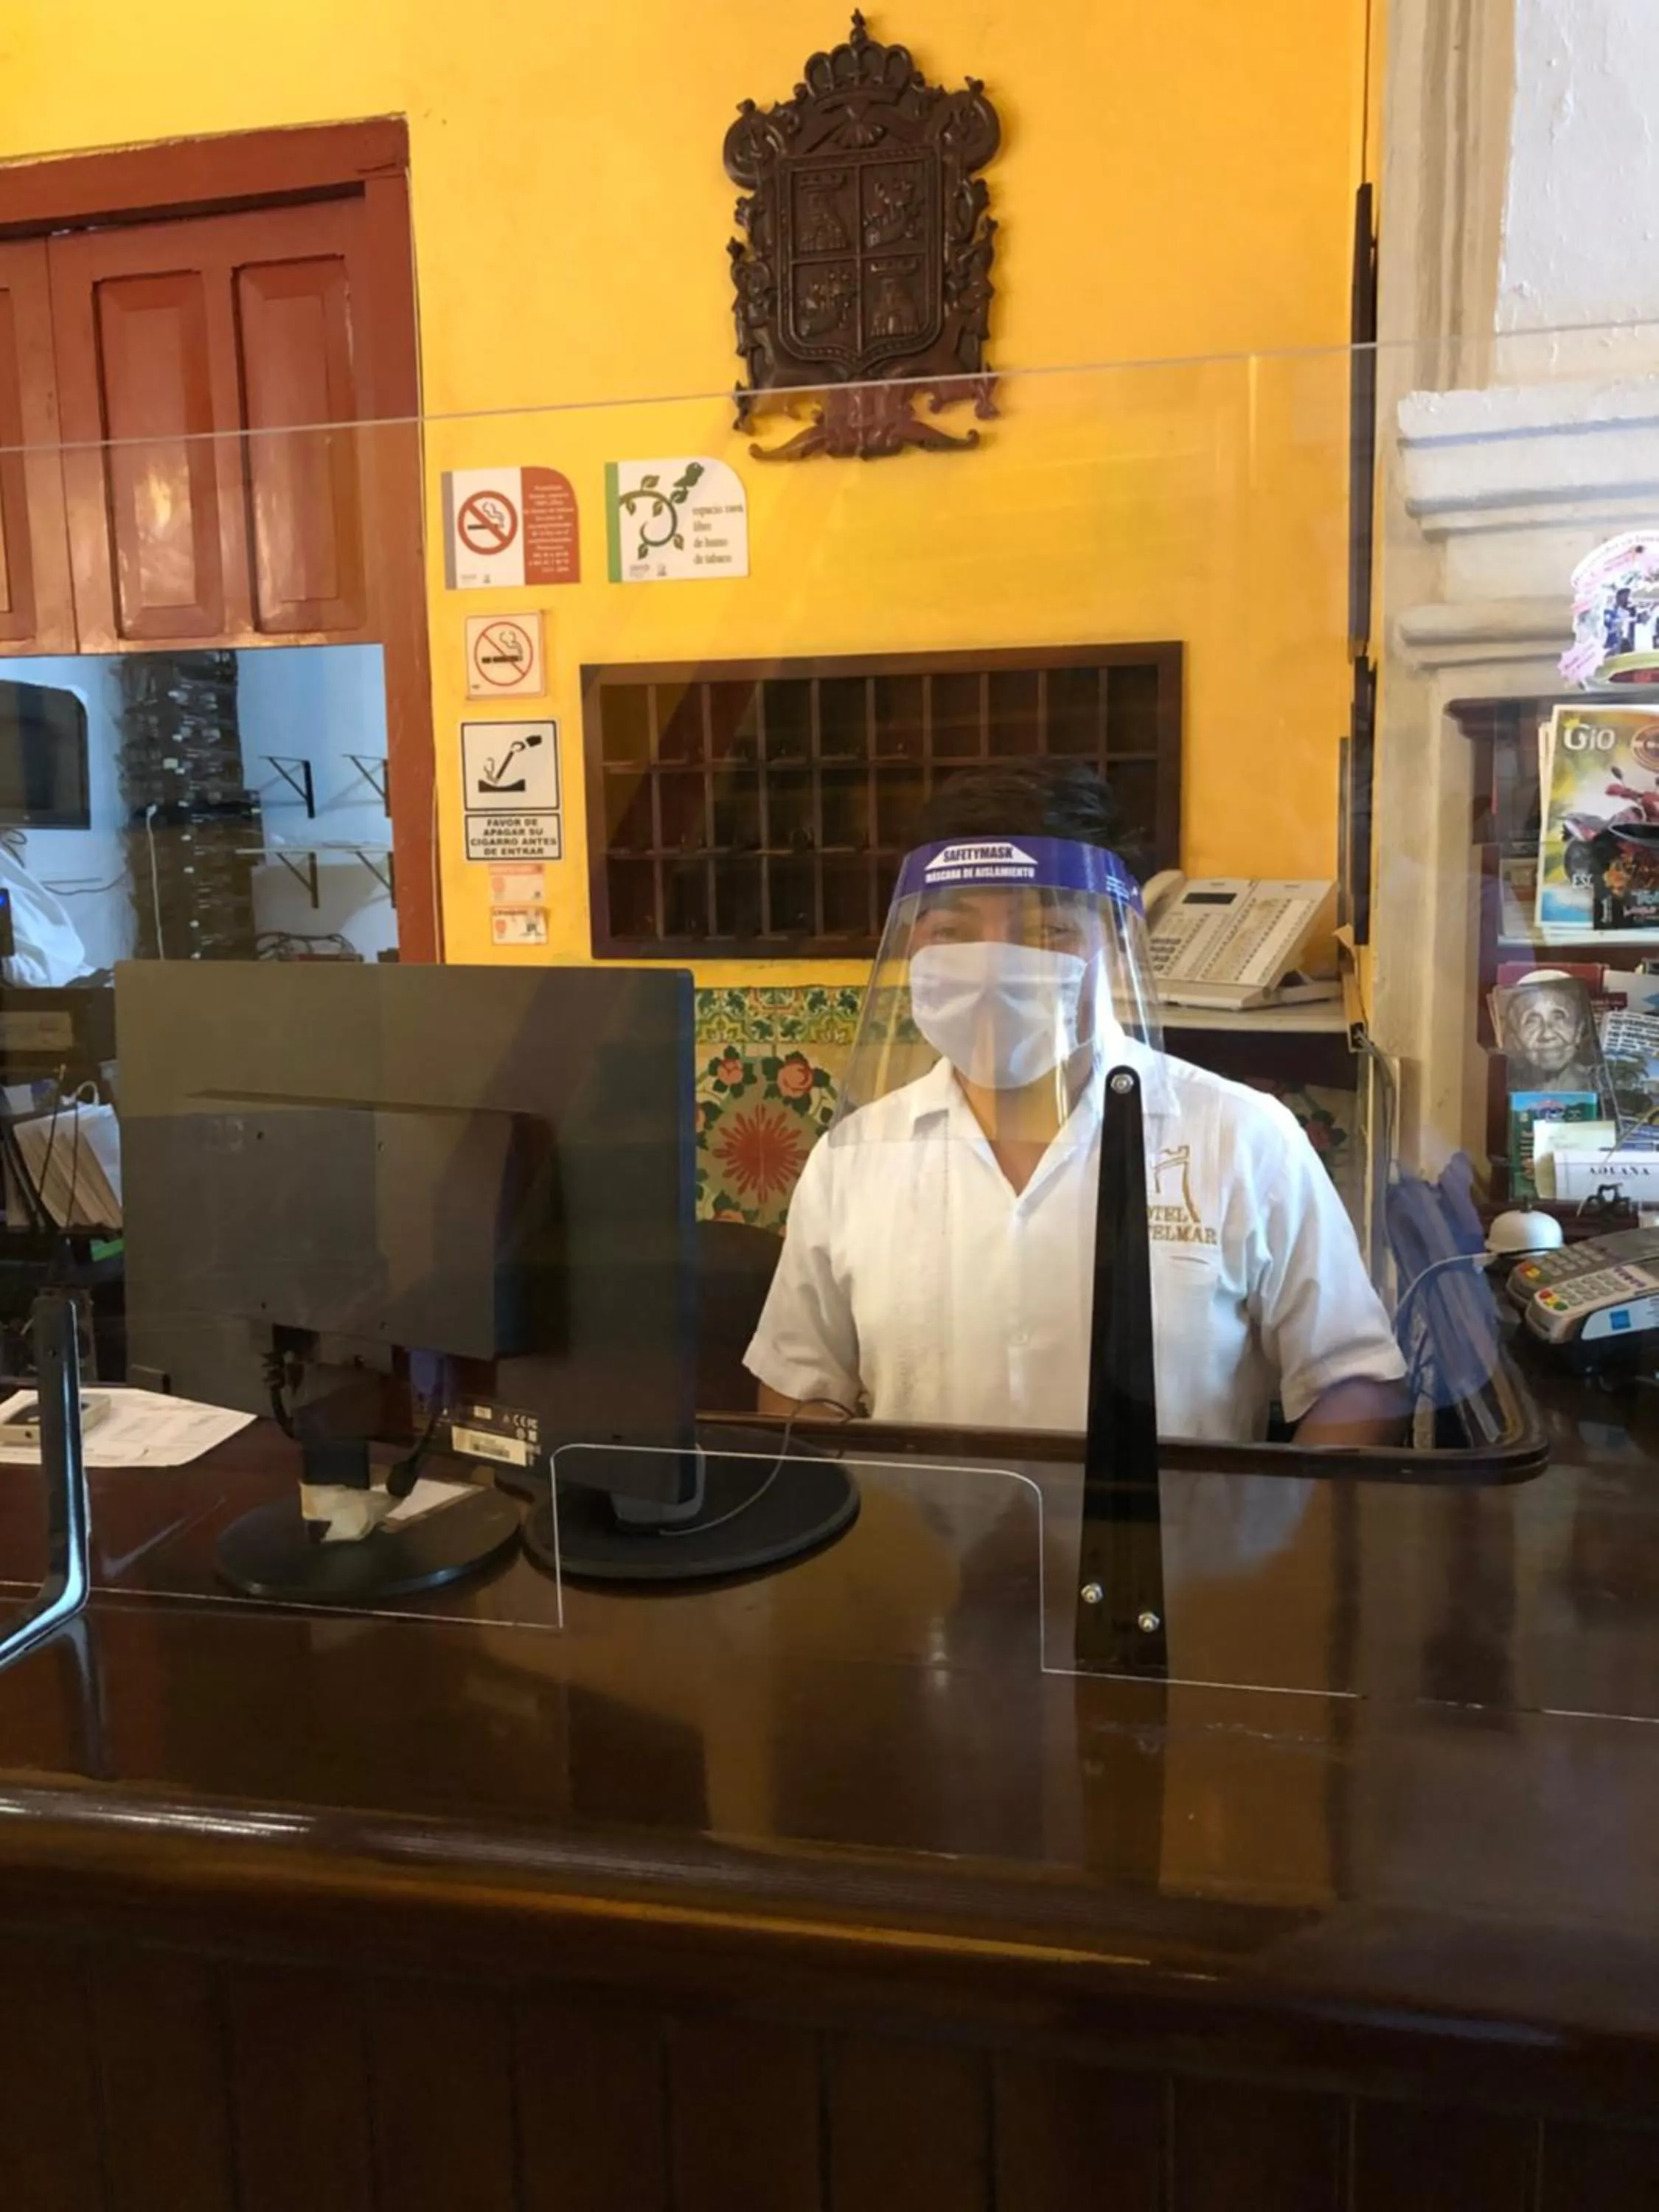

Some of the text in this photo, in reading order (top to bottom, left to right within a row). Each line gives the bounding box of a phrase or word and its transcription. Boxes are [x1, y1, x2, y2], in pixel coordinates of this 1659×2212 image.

[487, 818, 538, 827] FAVOR DE
[483, 828, 525, 836] APAGAR
[470, 837, 557, 846] CIGARRO ANTES
[484, 847, 544, 855] DE ENTRAR
[943, 846, 1013, 862] SAFETYMASK
